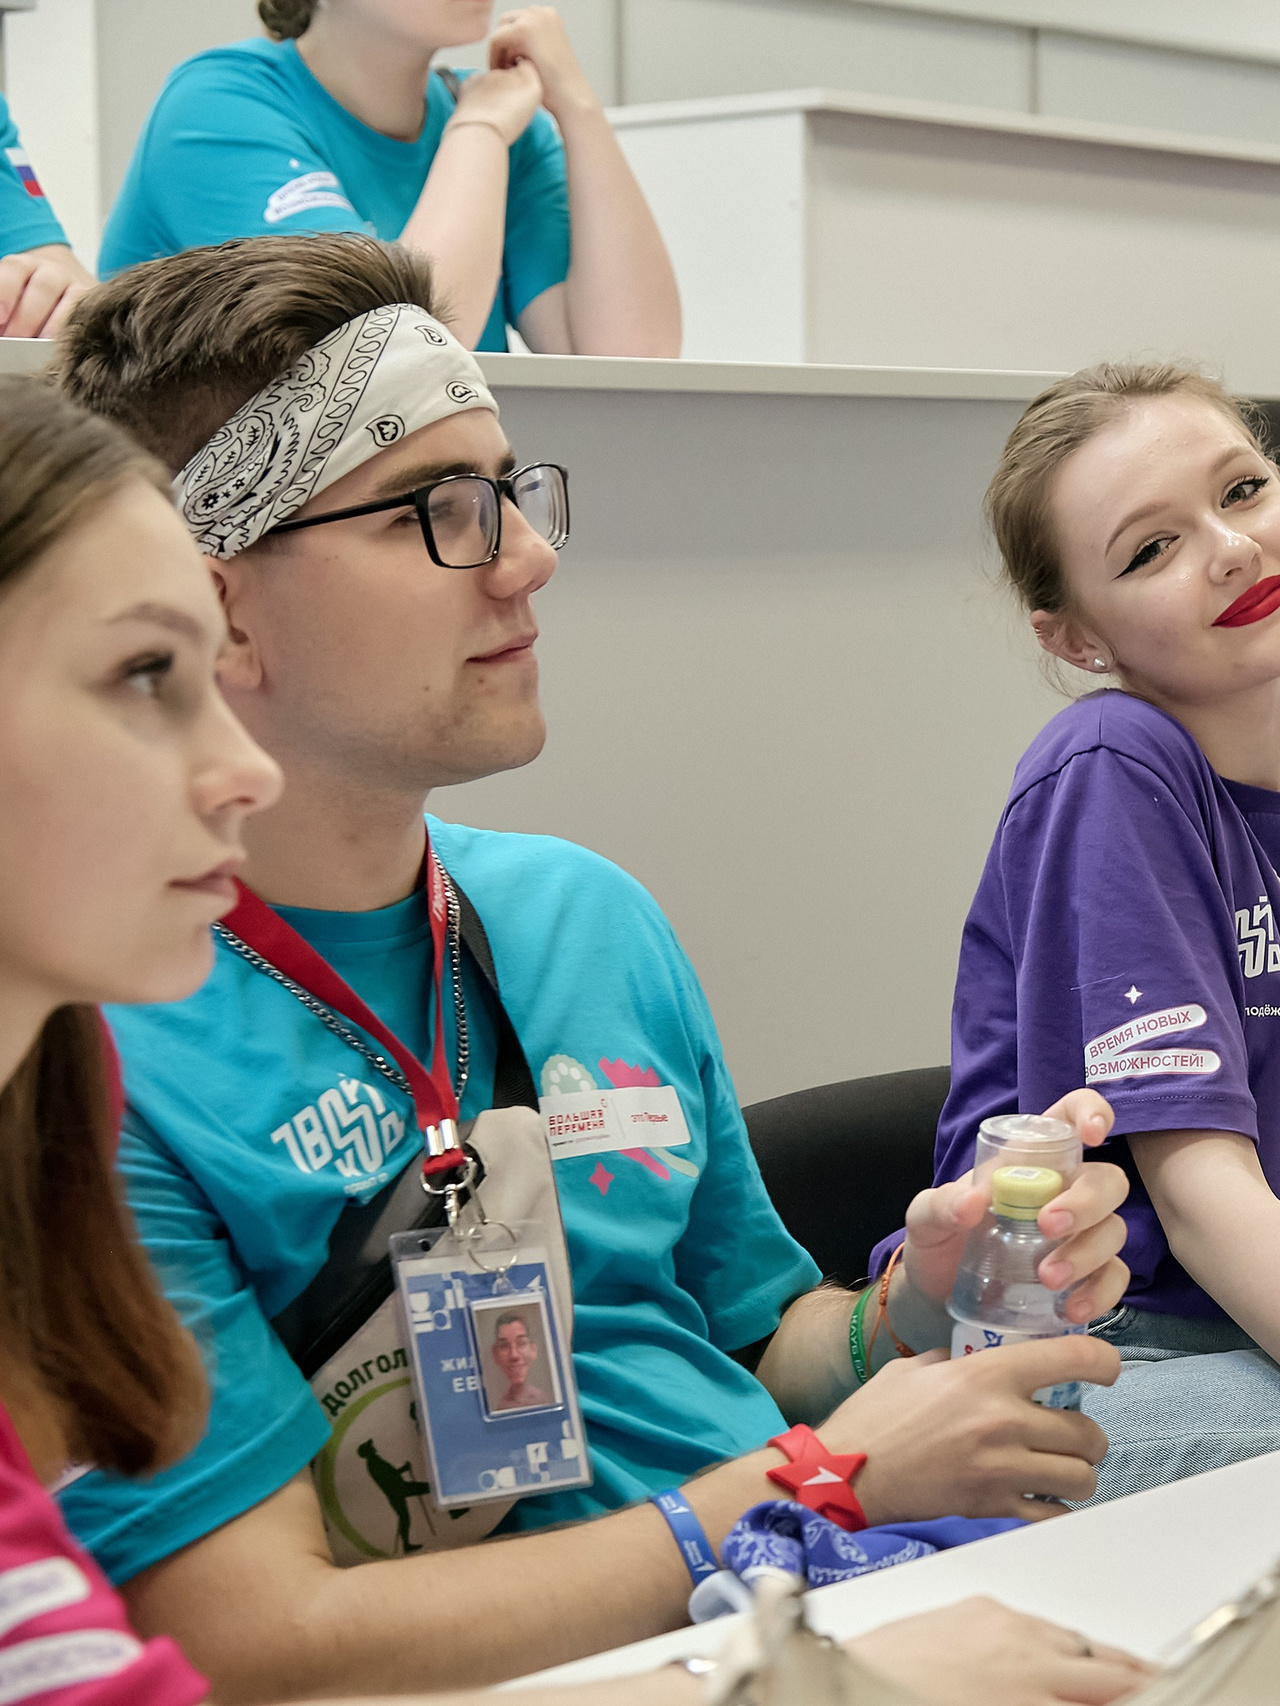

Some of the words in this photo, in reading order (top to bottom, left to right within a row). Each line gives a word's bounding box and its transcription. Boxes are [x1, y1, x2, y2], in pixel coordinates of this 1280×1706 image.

[1089, 1027, 1133, 1059] ВРЕМЯ
[1136, 1010, 1191, 1035] НОВЫХ
[549, 1109, 604, 1126] БОЛЬШАЯ
[549, 1119, 606, 1137] ПЕРЕМЕНА
[321, 1348, 408, 1417] ДОЛГОЛ
